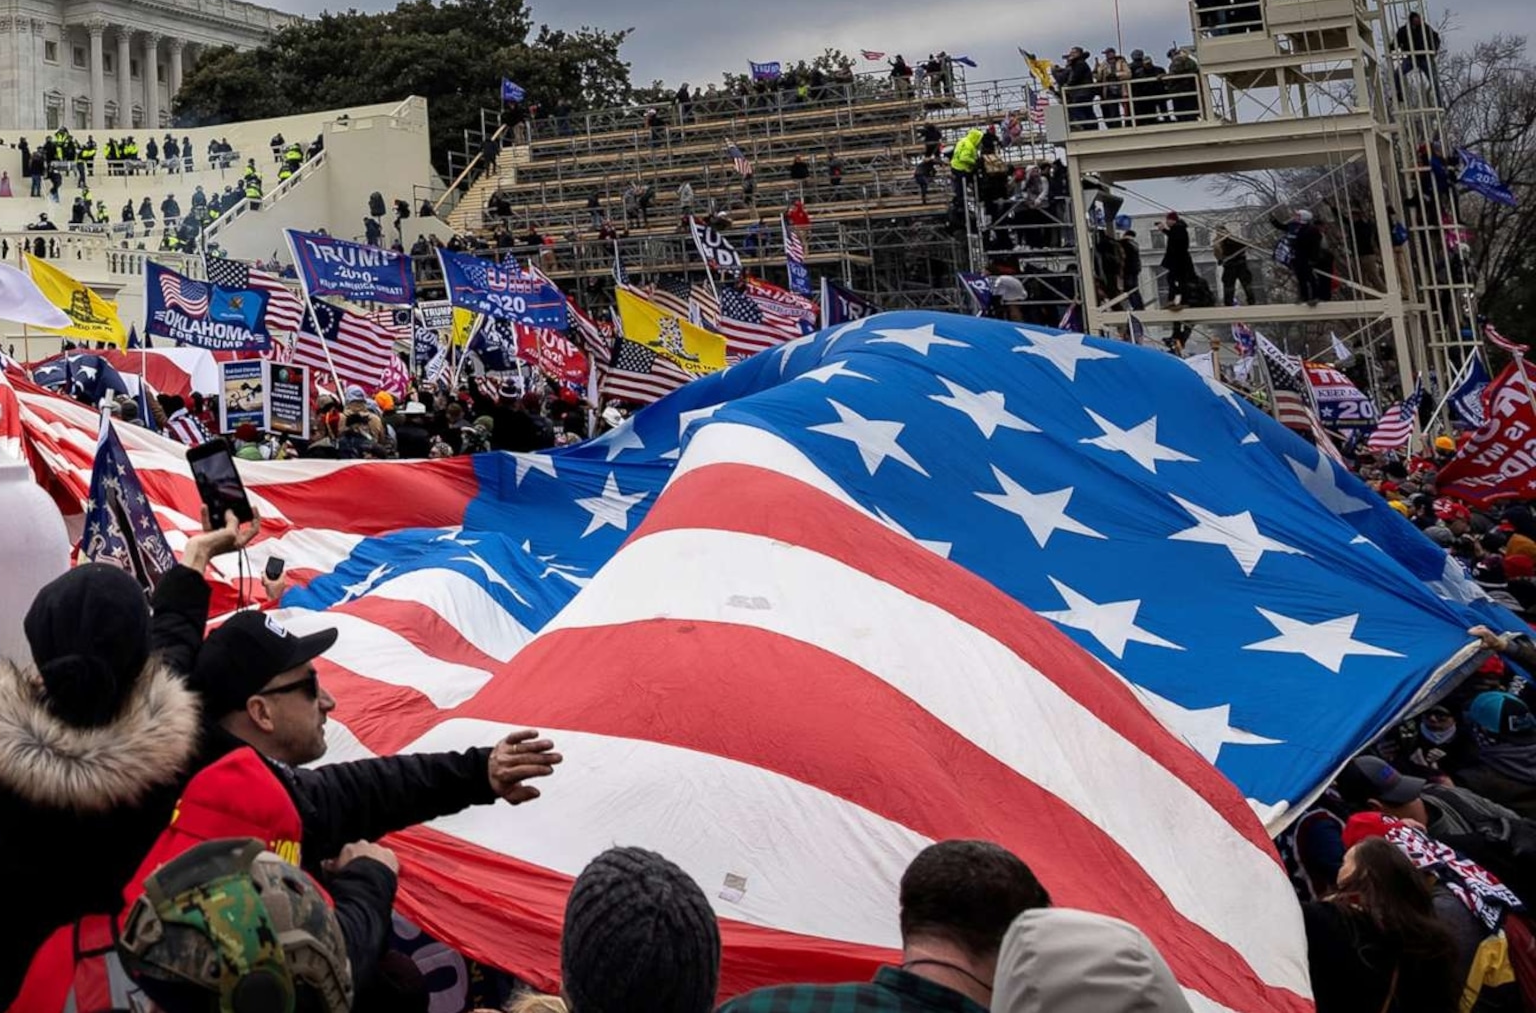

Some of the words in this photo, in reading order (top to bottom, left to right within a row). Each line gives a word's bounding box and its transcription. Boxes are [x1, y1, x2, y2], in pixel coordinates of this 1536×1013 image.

[305, 239, 398, 268] TRUMP
[164, 308, 254, 342] OKLAHOMA
[168, 327, 194, 343] FOR
[195, 334, 244, 349] TRUMP
